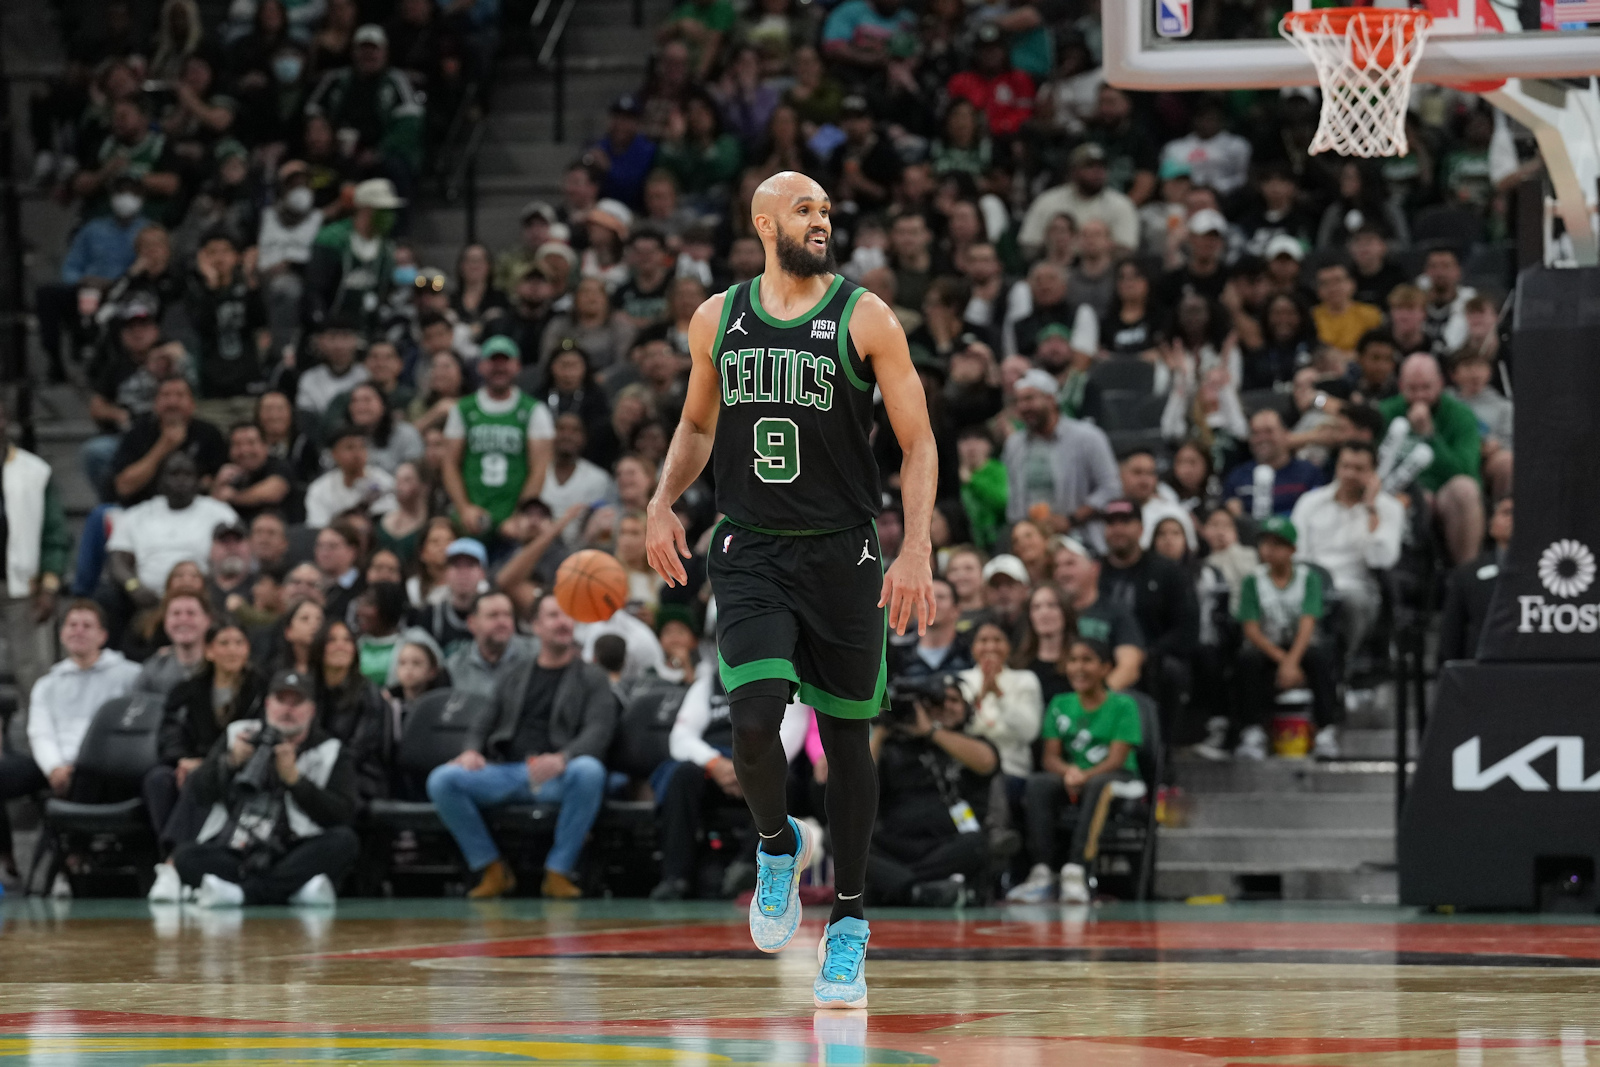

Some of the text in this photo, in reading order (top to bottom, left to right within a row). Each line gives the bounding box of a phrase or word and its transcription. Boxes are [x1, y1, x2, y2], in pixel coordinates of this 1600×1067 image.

[811, 330, 835, 340] PRINT
[812, 319, 836, 332] VISTA
[720, 348, 836, 411] CELTICS
[753, 417, 801, 483] 9
[1517, 594, 1600, 634] Fros
[1452, 735, 1600, 792] KI
